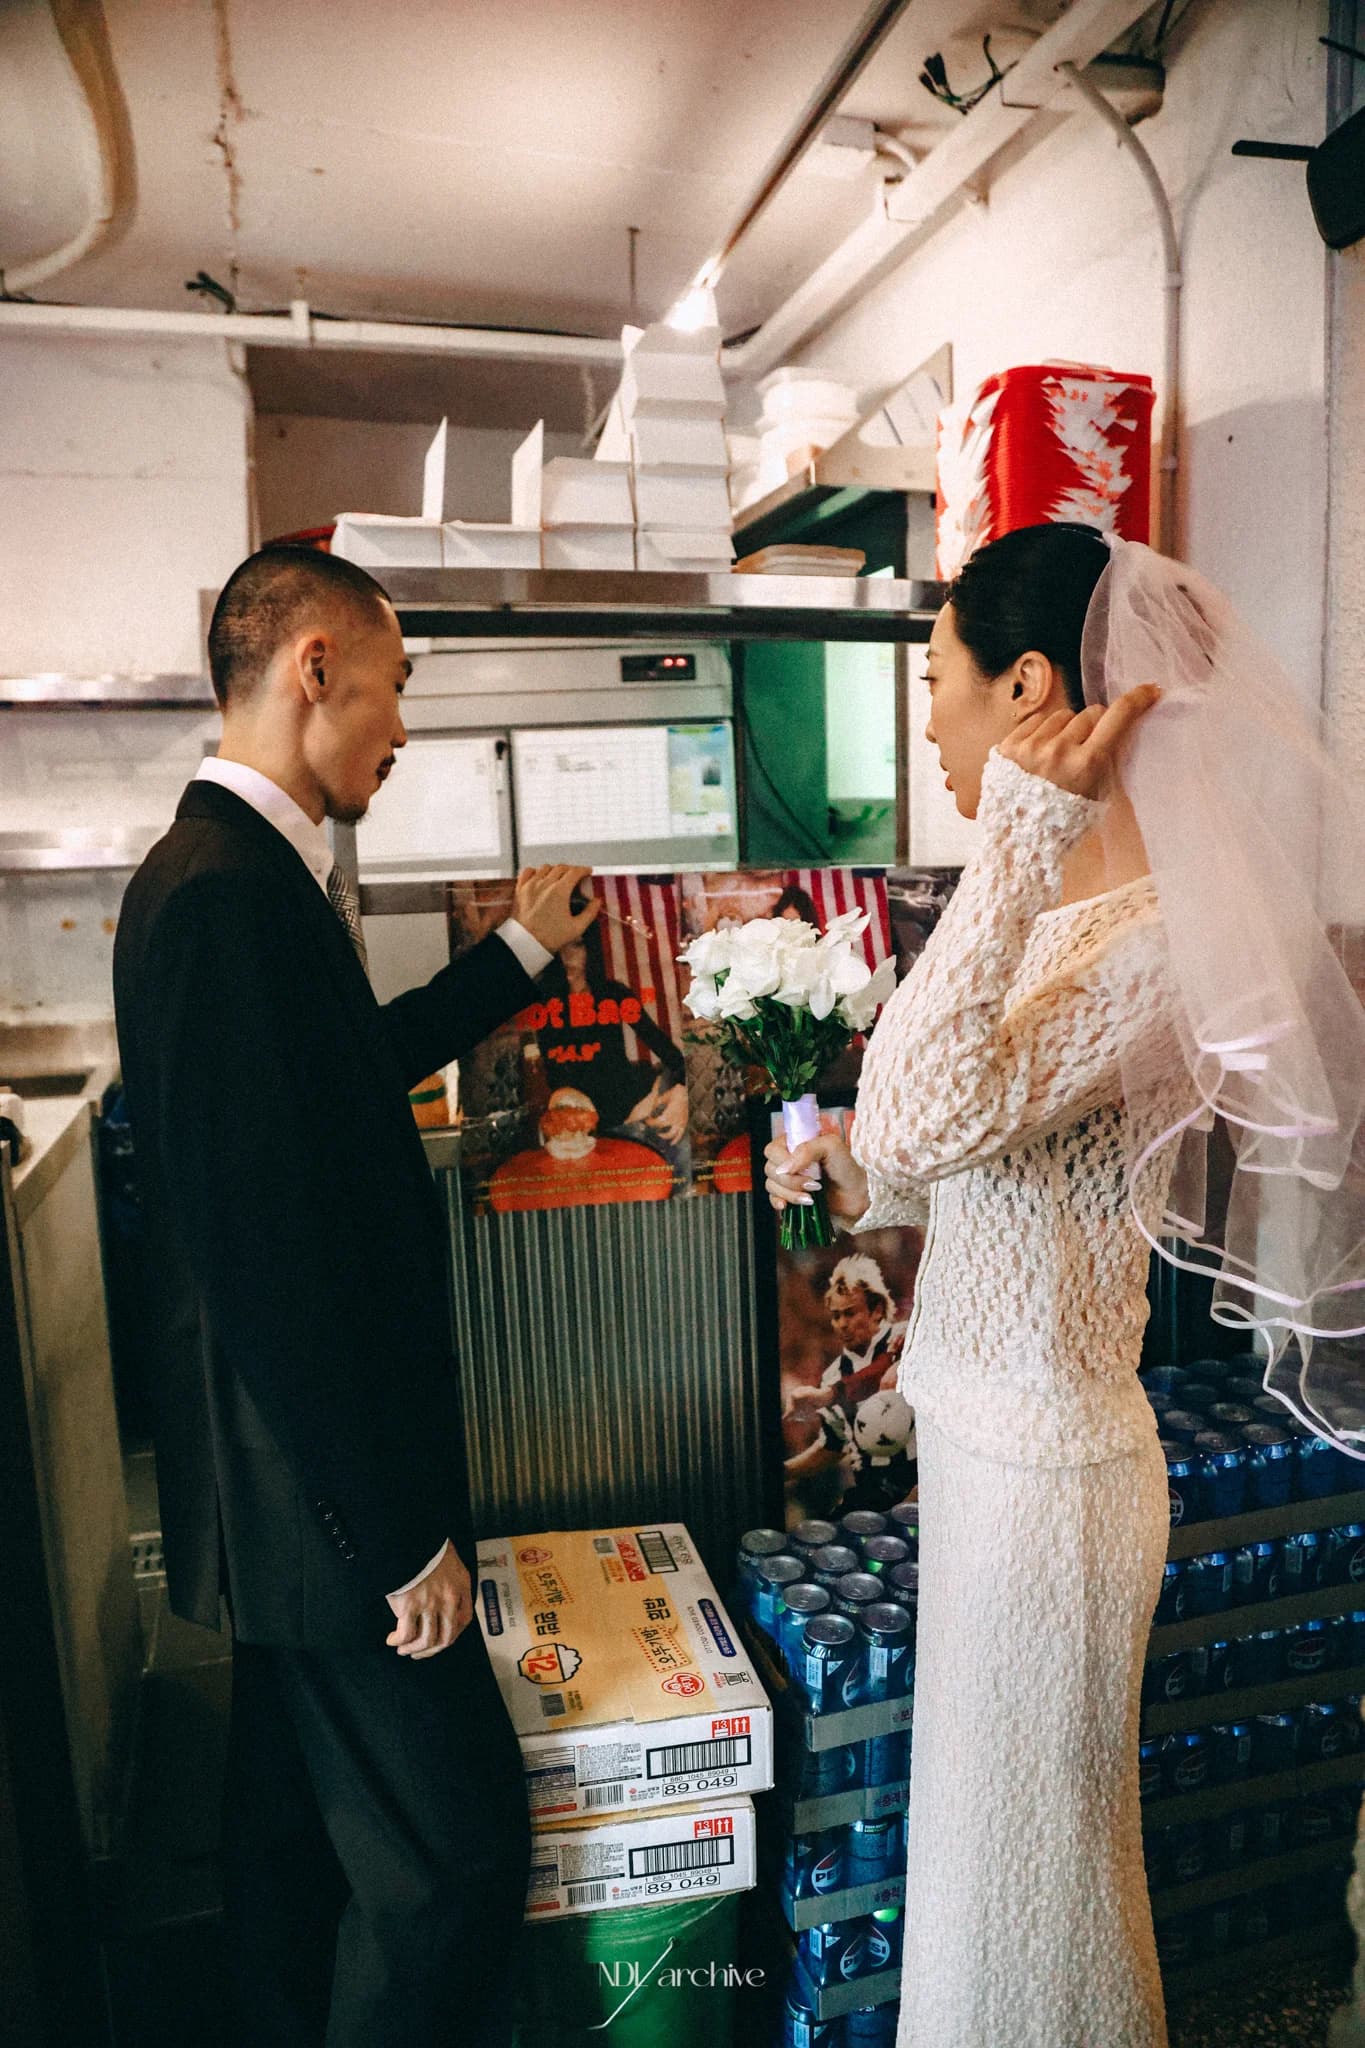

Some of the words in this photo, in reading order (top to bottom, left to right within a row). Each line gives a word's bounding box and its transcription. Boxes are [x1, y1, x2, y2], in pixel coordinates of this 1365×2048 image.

[515, 997, 564, 1030] ot
[643, 1597, 671, 1621] 흰밥
[533, 1611, 561, 1636] 흰밥
[642, 1626, 677, 1666] 오뚜기밥
[527, 1653, 558, 1674] 12
[714, 1720, 728, 1730] 13
[664, 1783, 683, 1796] 89
[696, 1775, 735, 1791] 049
[697, 1821, 711, 1829] 13
[647, 1882, 666, 1894] 89
[679, 1874, 718, 1889] 049
